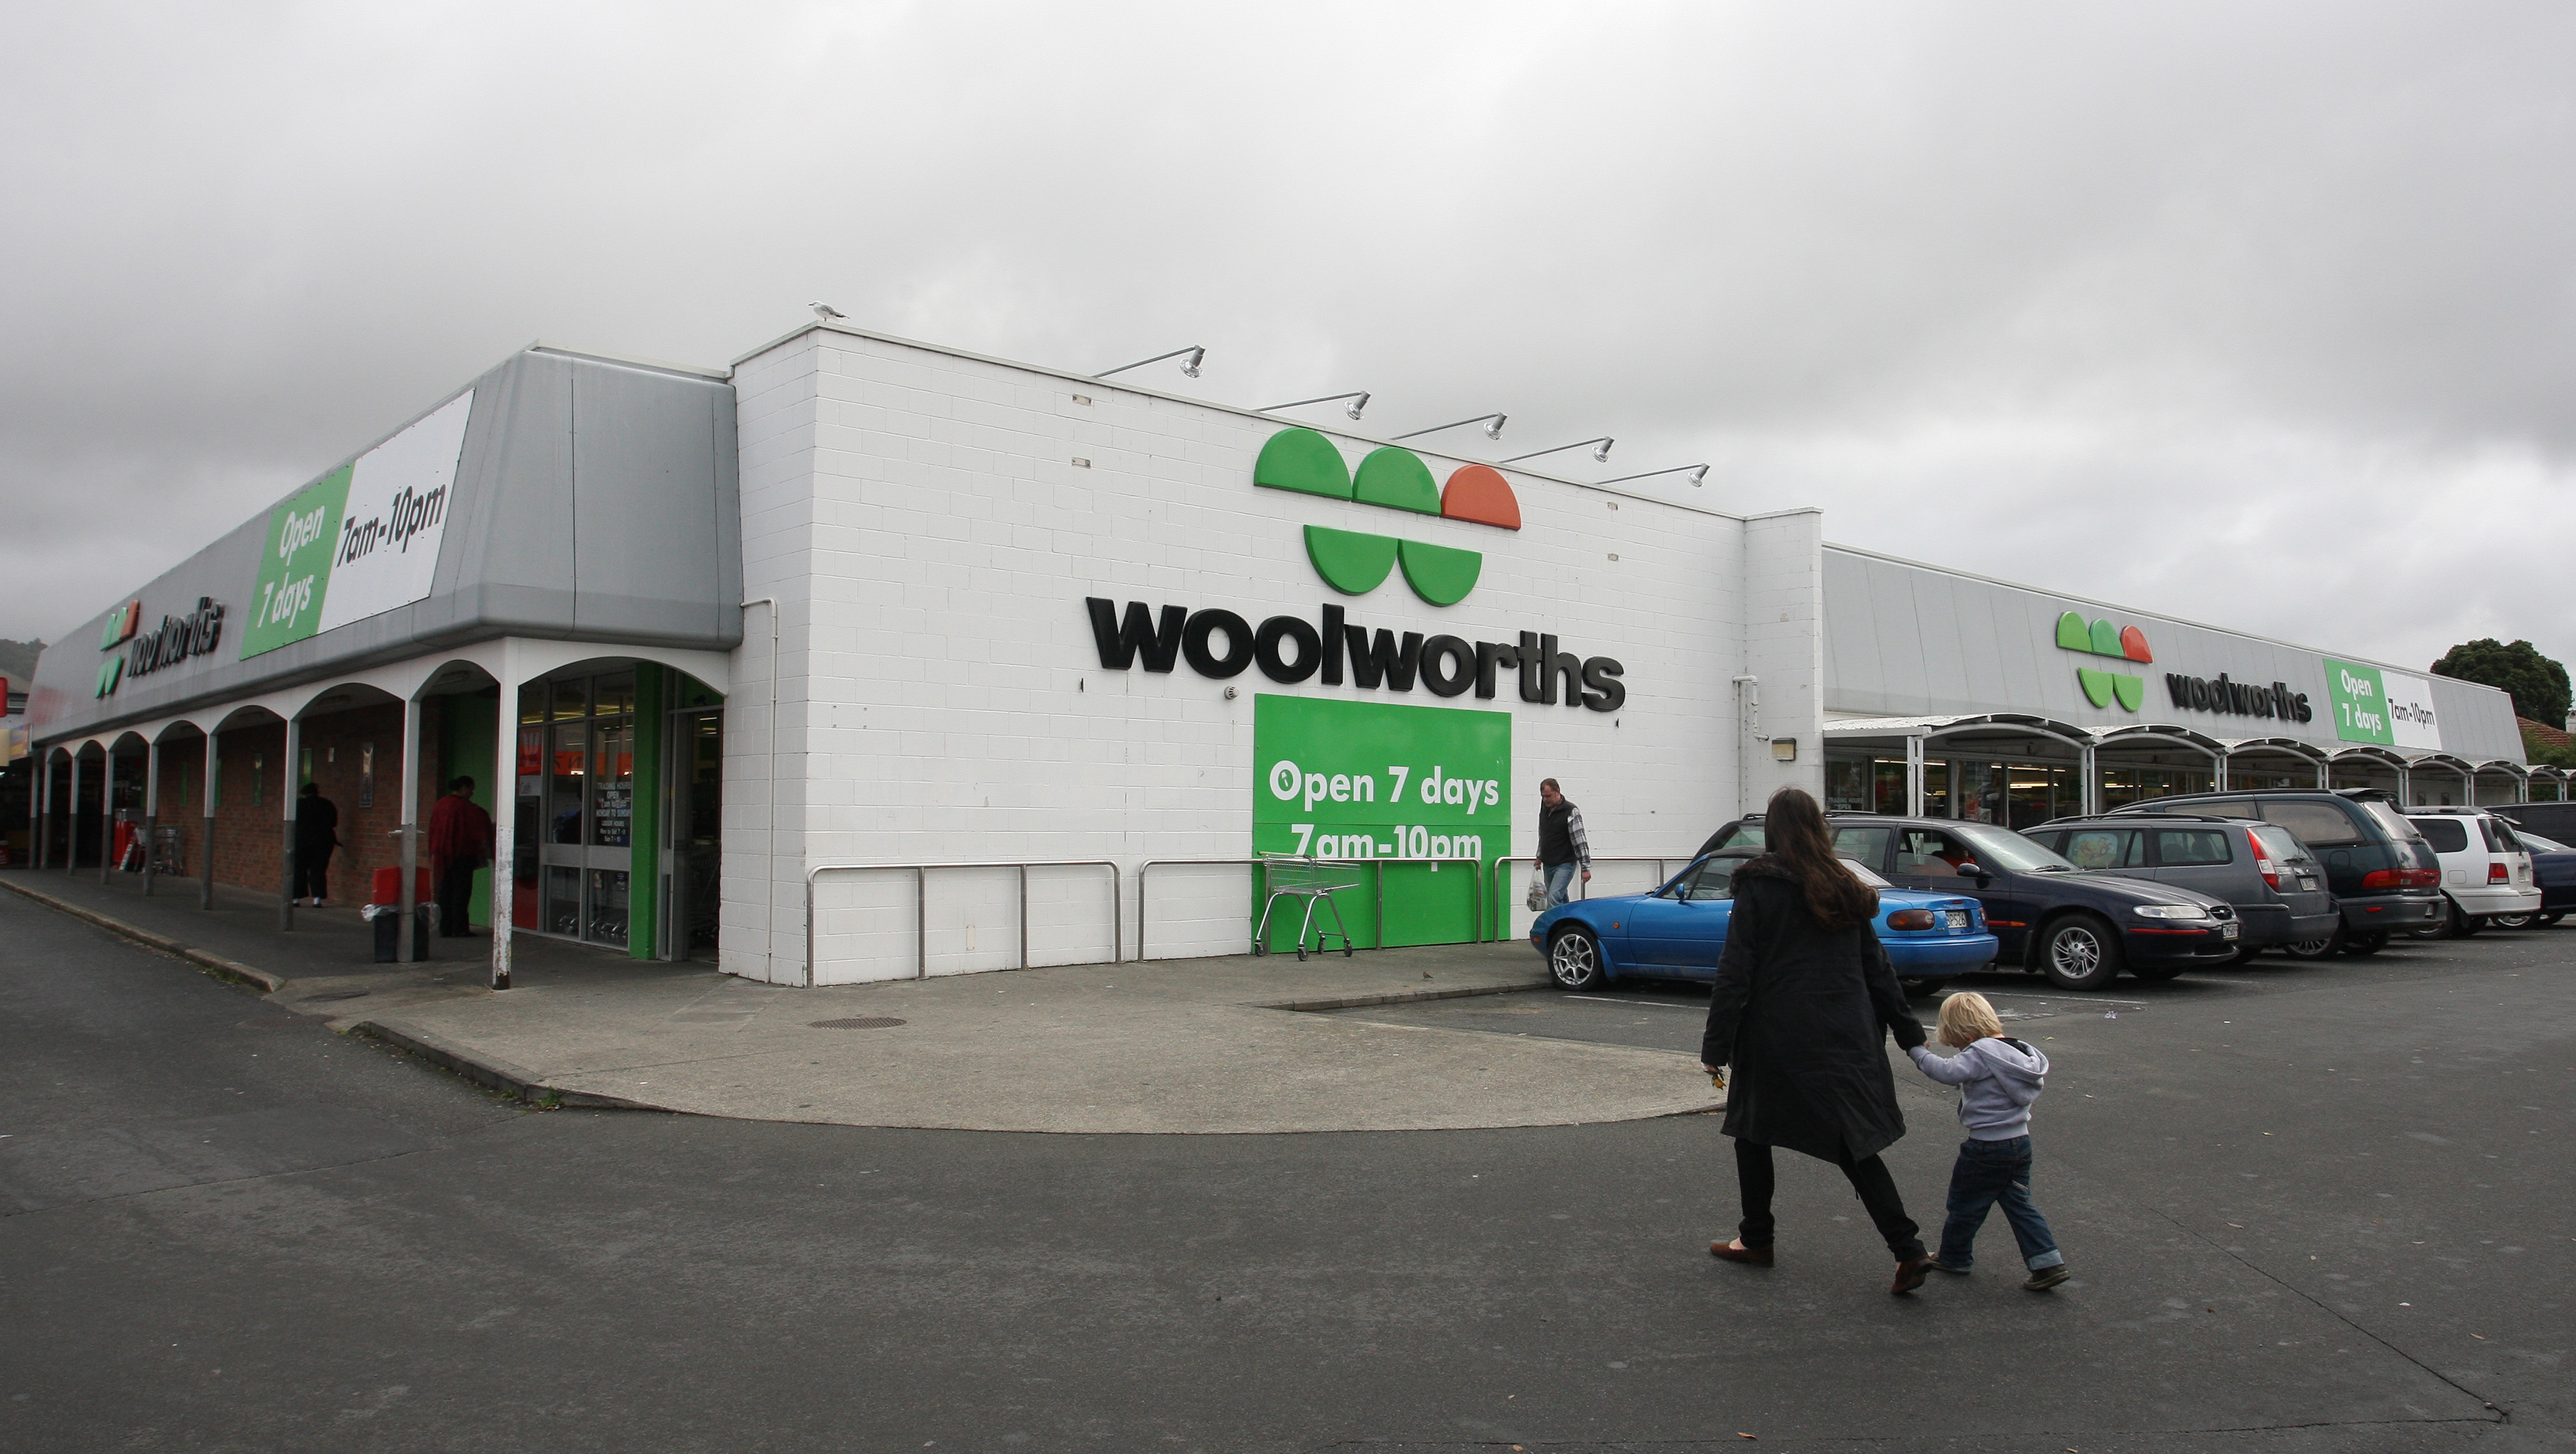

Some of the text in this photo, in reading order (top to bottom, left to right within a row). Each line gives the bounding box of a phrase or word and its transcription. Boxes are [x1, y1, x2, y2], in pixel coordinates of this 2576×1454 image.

[279, 505, 326, 566] Open
[336, 484, 446, 567] 7am-10pm
[257, 572, 314, 629] 7 days
[1085, 596, 1626, 712] woolworths
[2167, 672, 2312, 723] woolworths
[2341, 669, 2373, 700] Open
[2342, 703, 2381, 736] 7 days
[2388, 698, 2436, 731] 7am-10pm
[1270, 760, 1499, 814] Open 7 days
[1291, 824, 1482, 872] 7am-10pm
